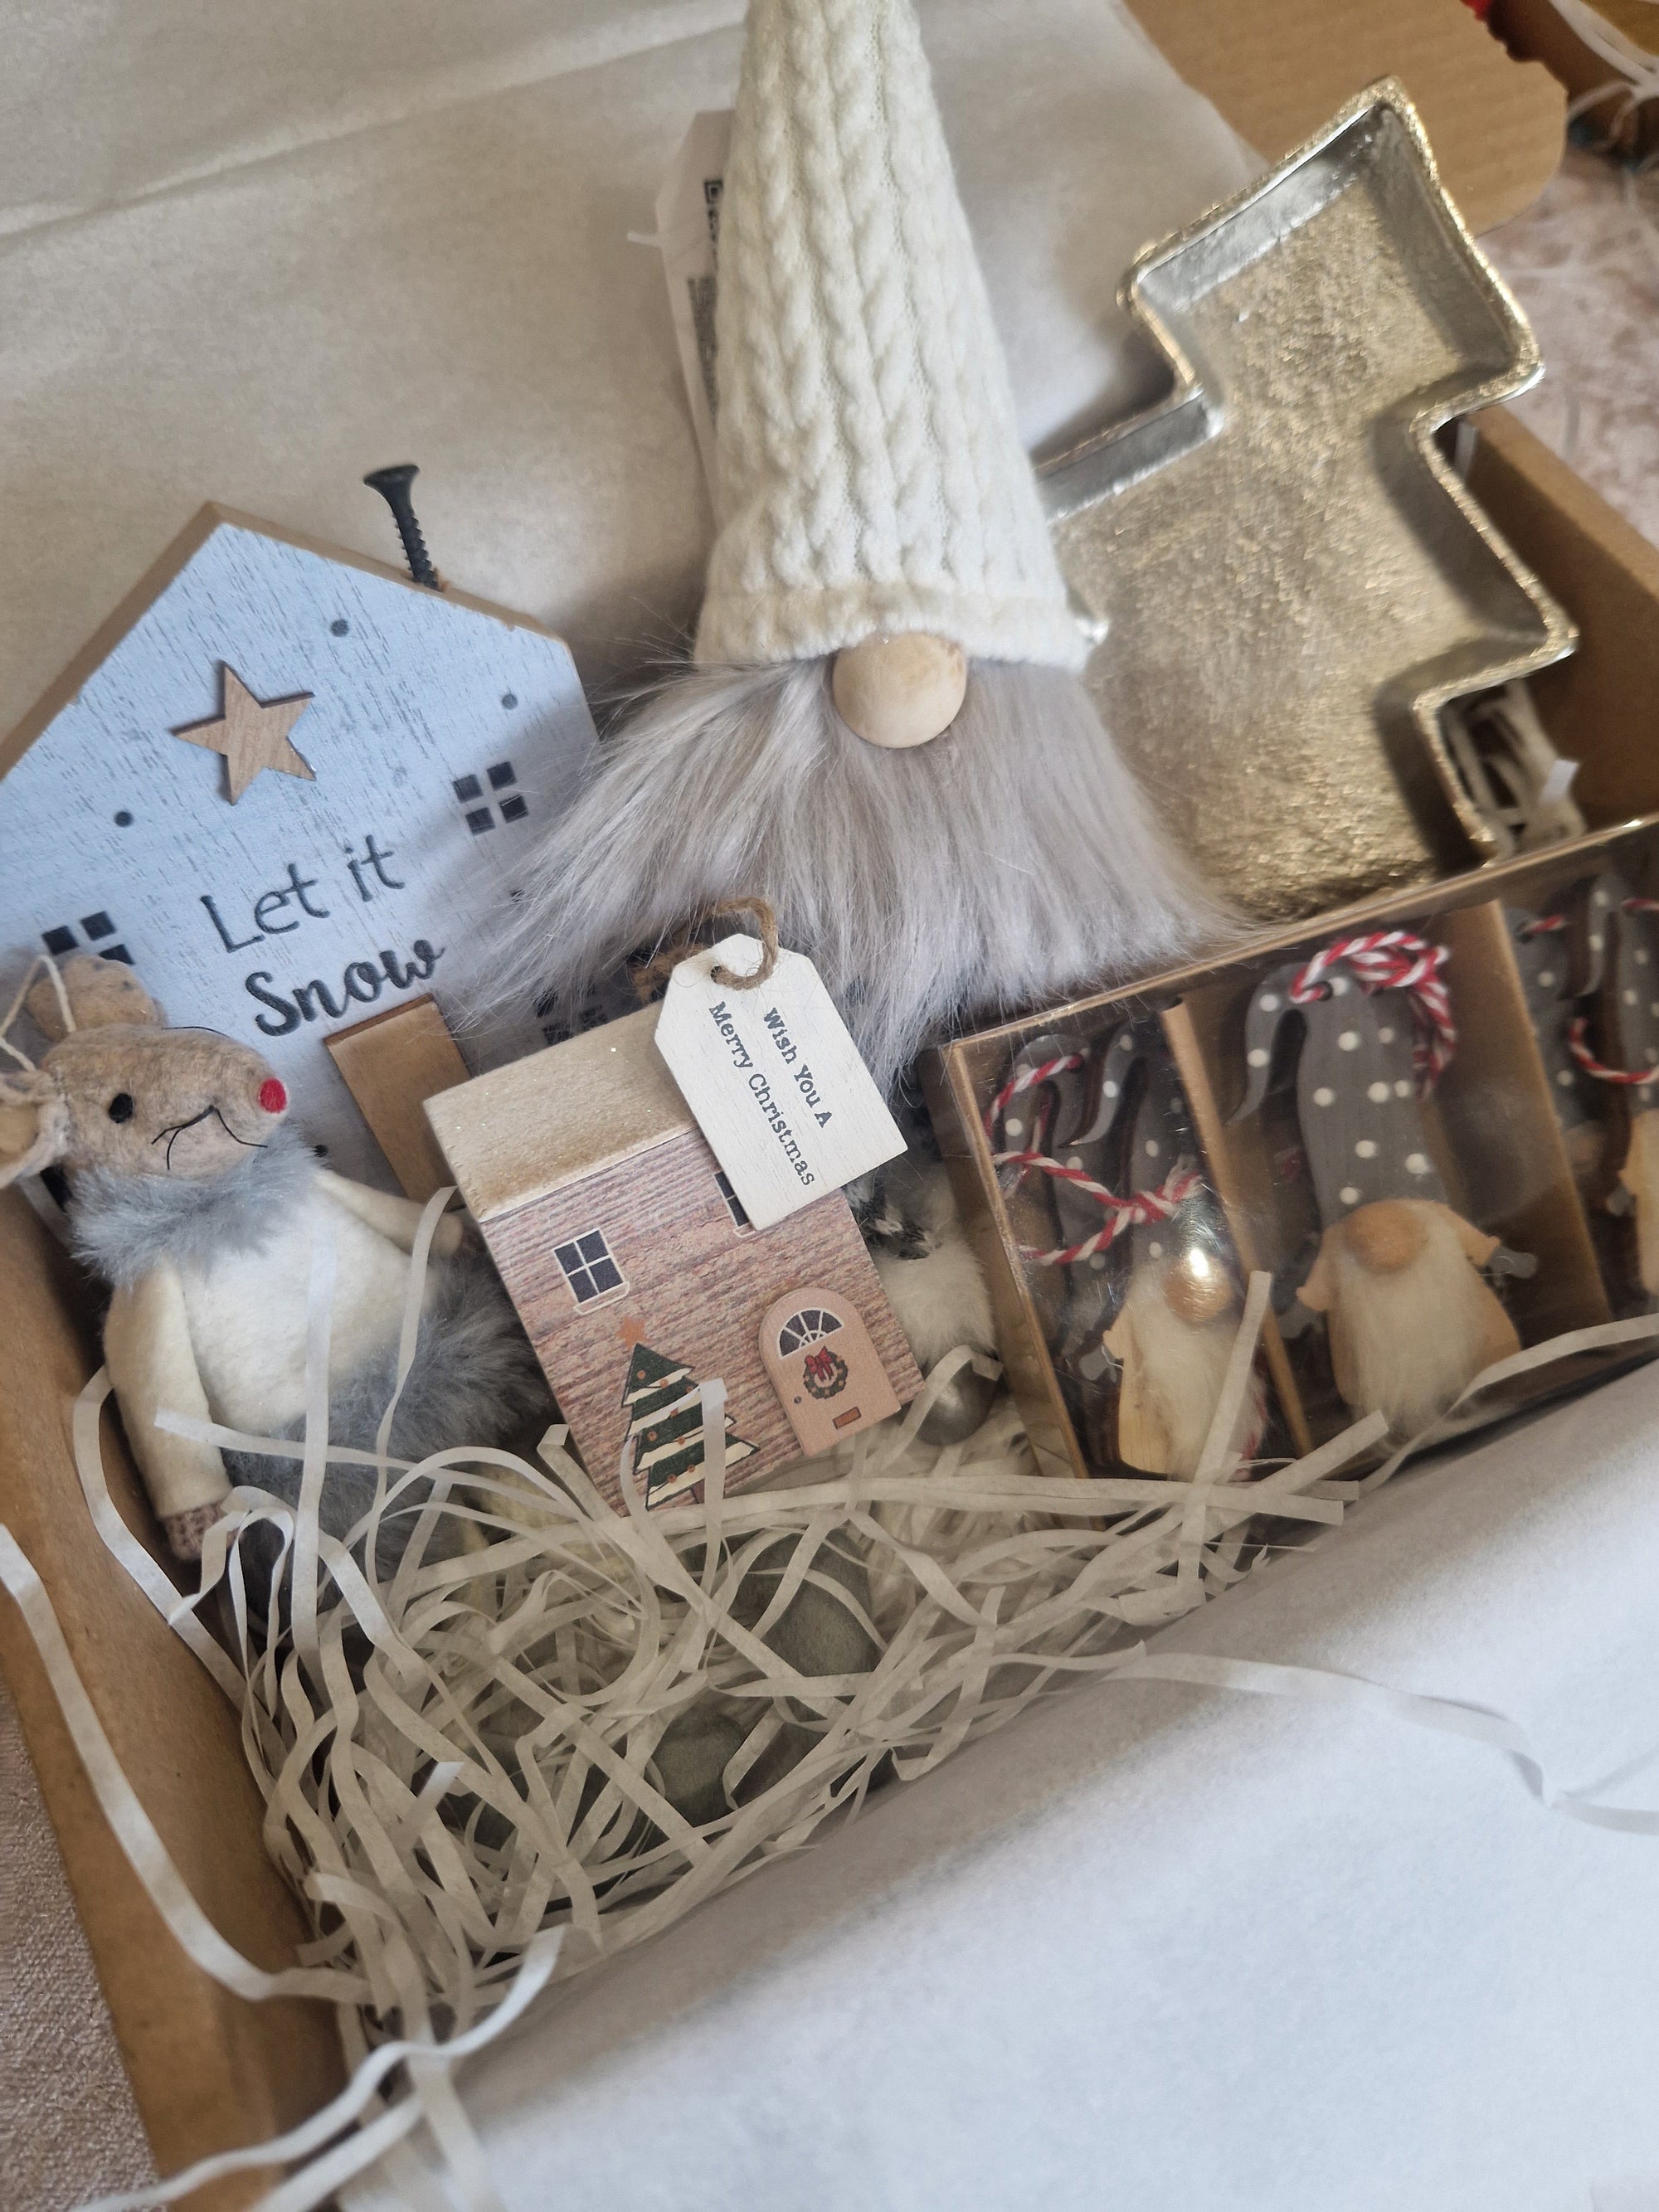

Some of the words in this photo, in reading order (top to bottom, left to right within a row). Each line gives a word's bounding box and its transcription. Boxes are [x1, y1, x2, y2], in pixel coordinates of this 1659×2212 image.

[200, 863, 330, 953] Let
[345, 834, 405, 902] it
[245, 939, 446, 1037] Snow
[708, 1000, 754, 1069] Merry
[748, 1072, 815, 1186] Christmas
[763, 1007, 798, 1064] Wish
[794, 1064, 821, 1108] You
[815, 1111, 833, 1128] A
